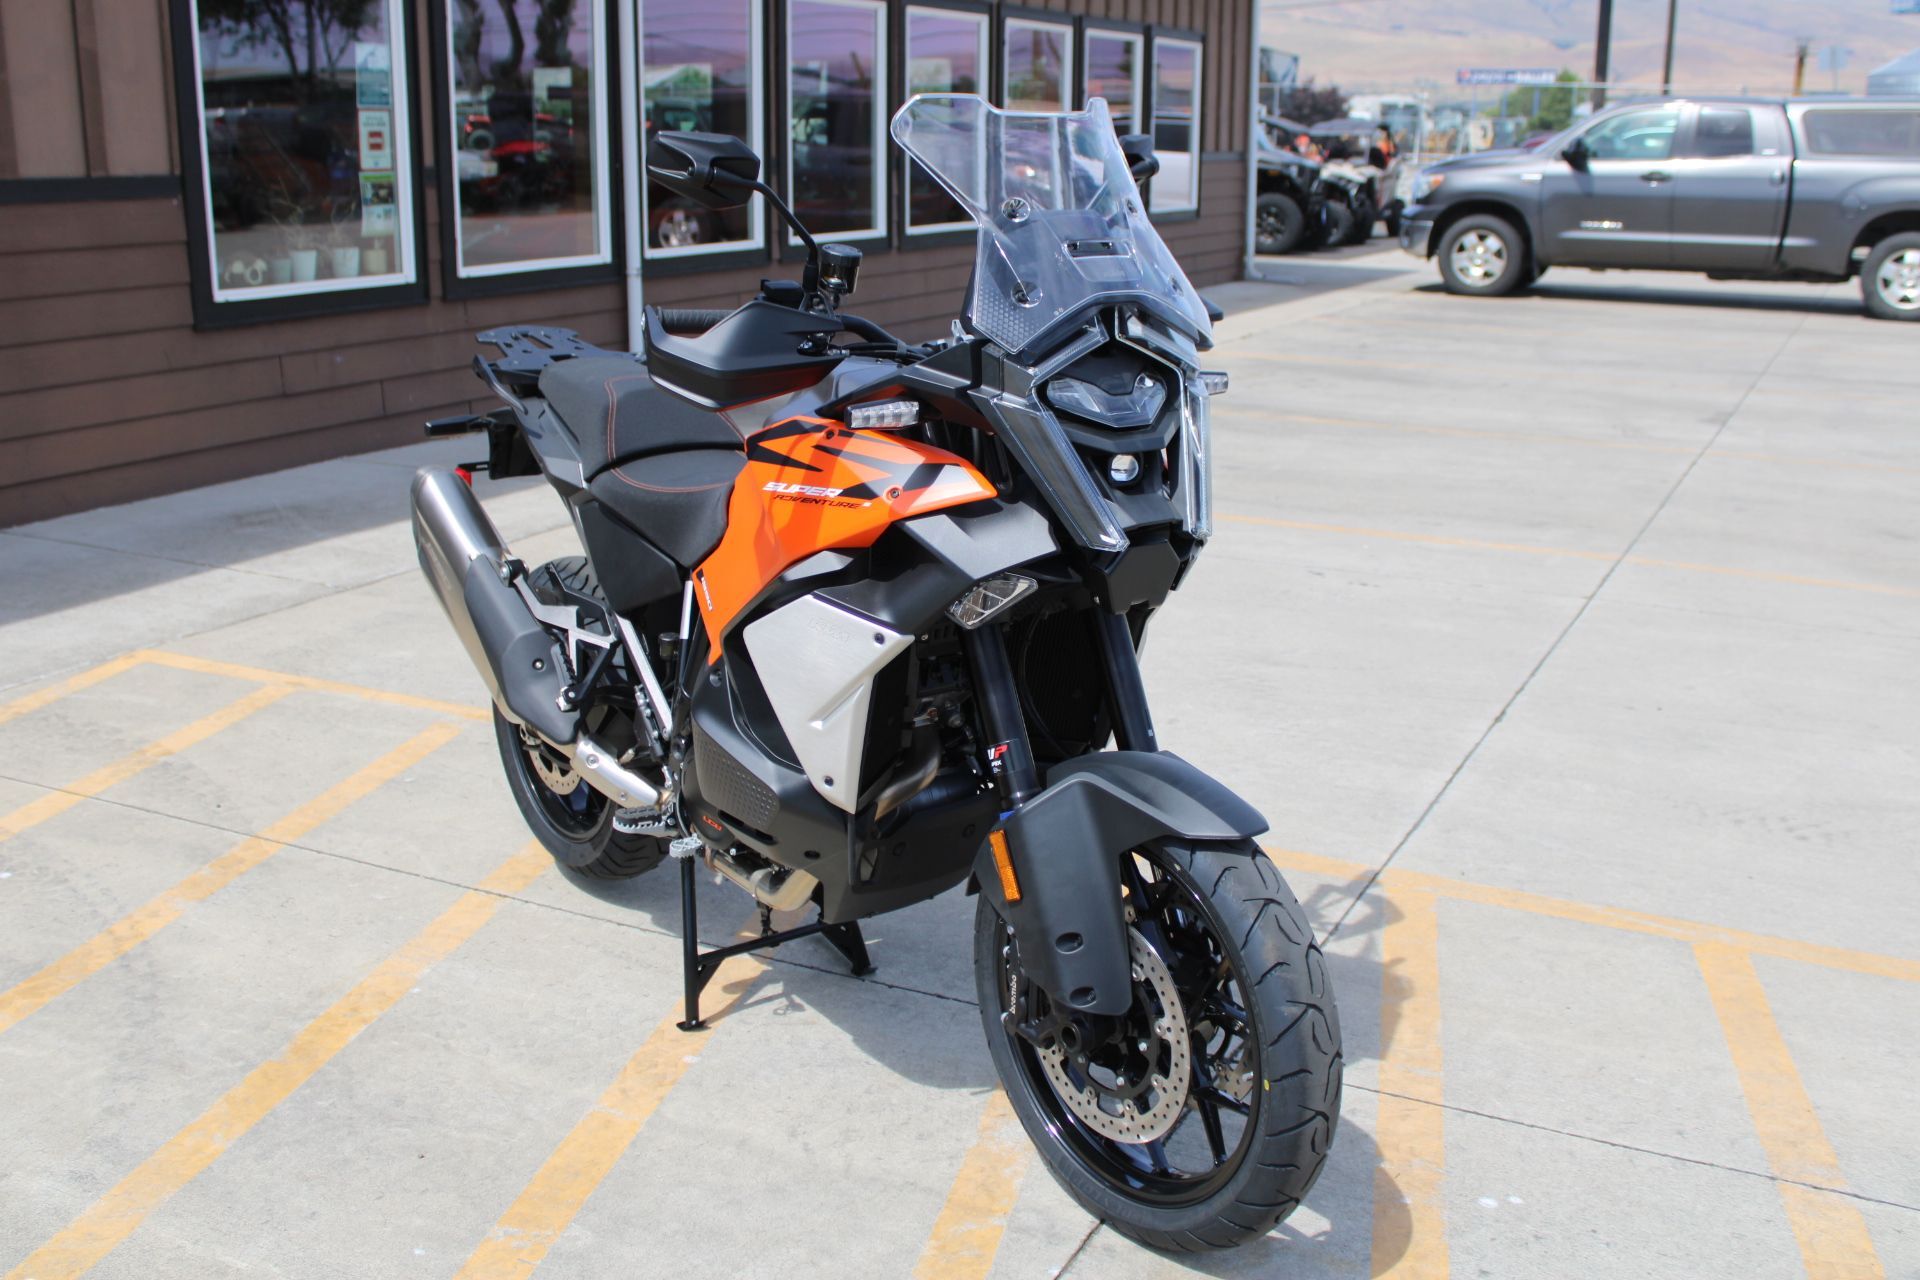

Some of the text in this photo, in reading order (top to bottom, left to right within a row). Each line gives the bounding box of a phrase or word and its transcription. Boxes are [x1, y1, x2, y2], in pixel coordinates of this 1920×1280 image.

[762, 481, 843, 498] SUPER
[774, 494, 861, 510] ADVENTURE
[1009, 974, 1017, 1015] brembo
